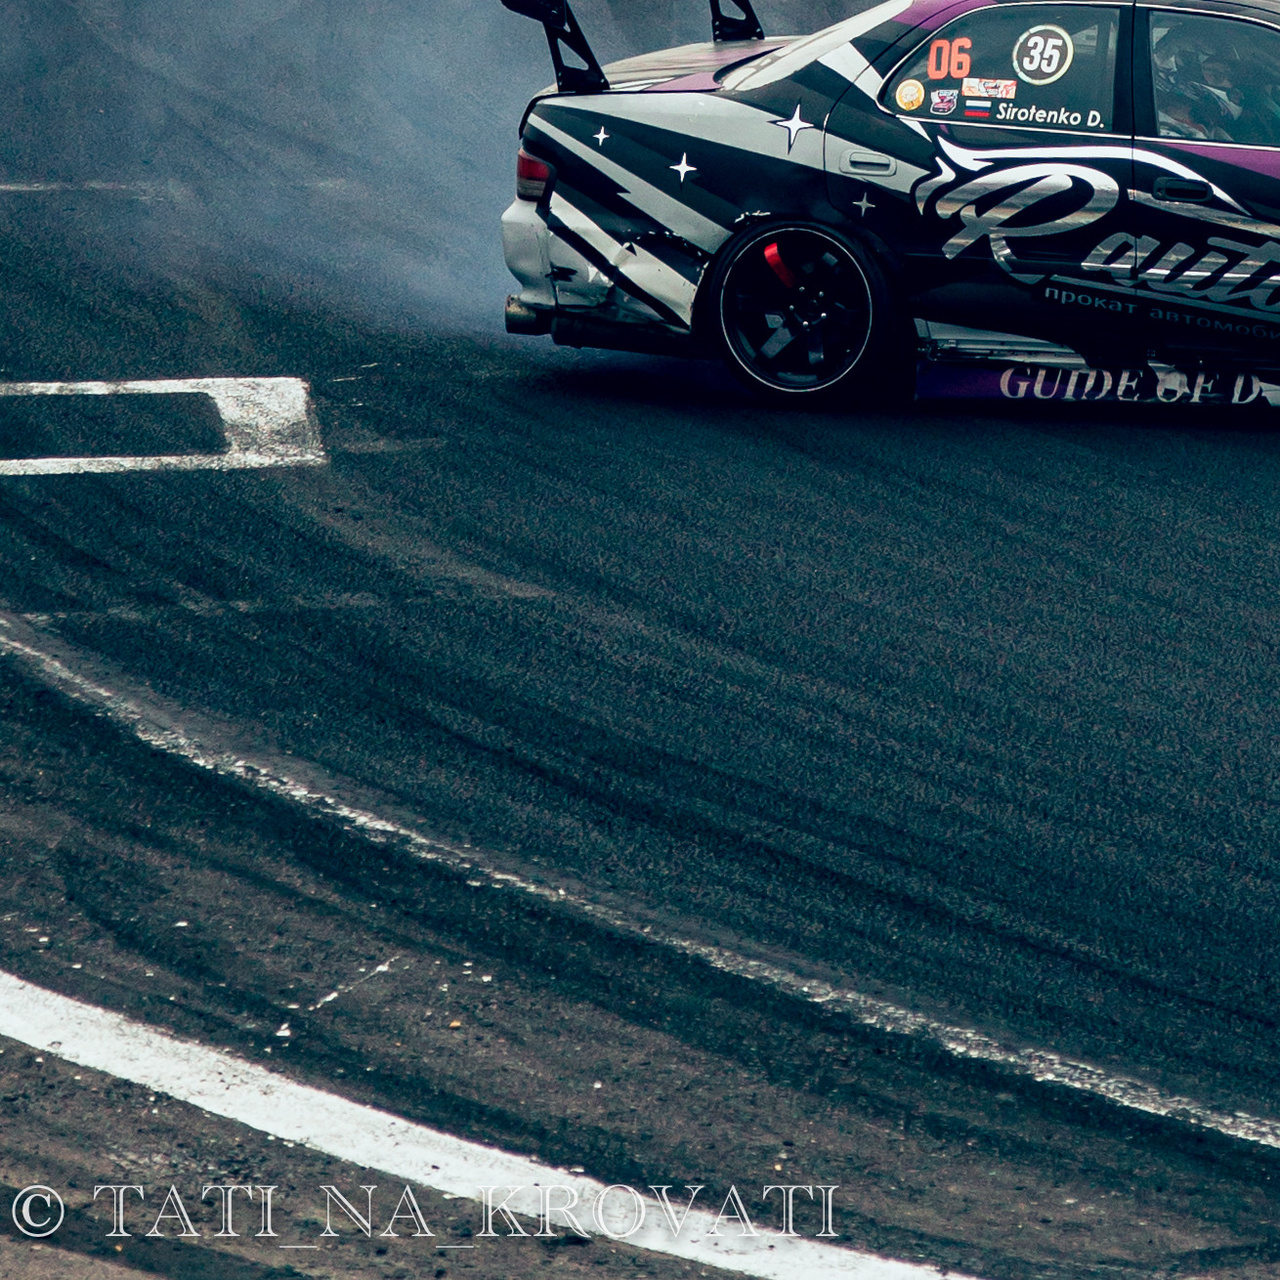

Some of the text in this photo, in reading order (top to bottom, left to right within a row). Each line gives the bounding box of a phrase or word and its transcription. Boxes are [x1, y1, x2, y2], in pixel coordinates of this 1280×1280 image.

[927, 37, 972, 80] 06
[1022, 35, 1063, 74] 35
[995, 103, 1105, 128] Sirotenko D.
[1044, 286, 1138, 314] прокат
[1000, 367, 1144, 402] GUIDE
[1156, 370, 1220, 403] OF
